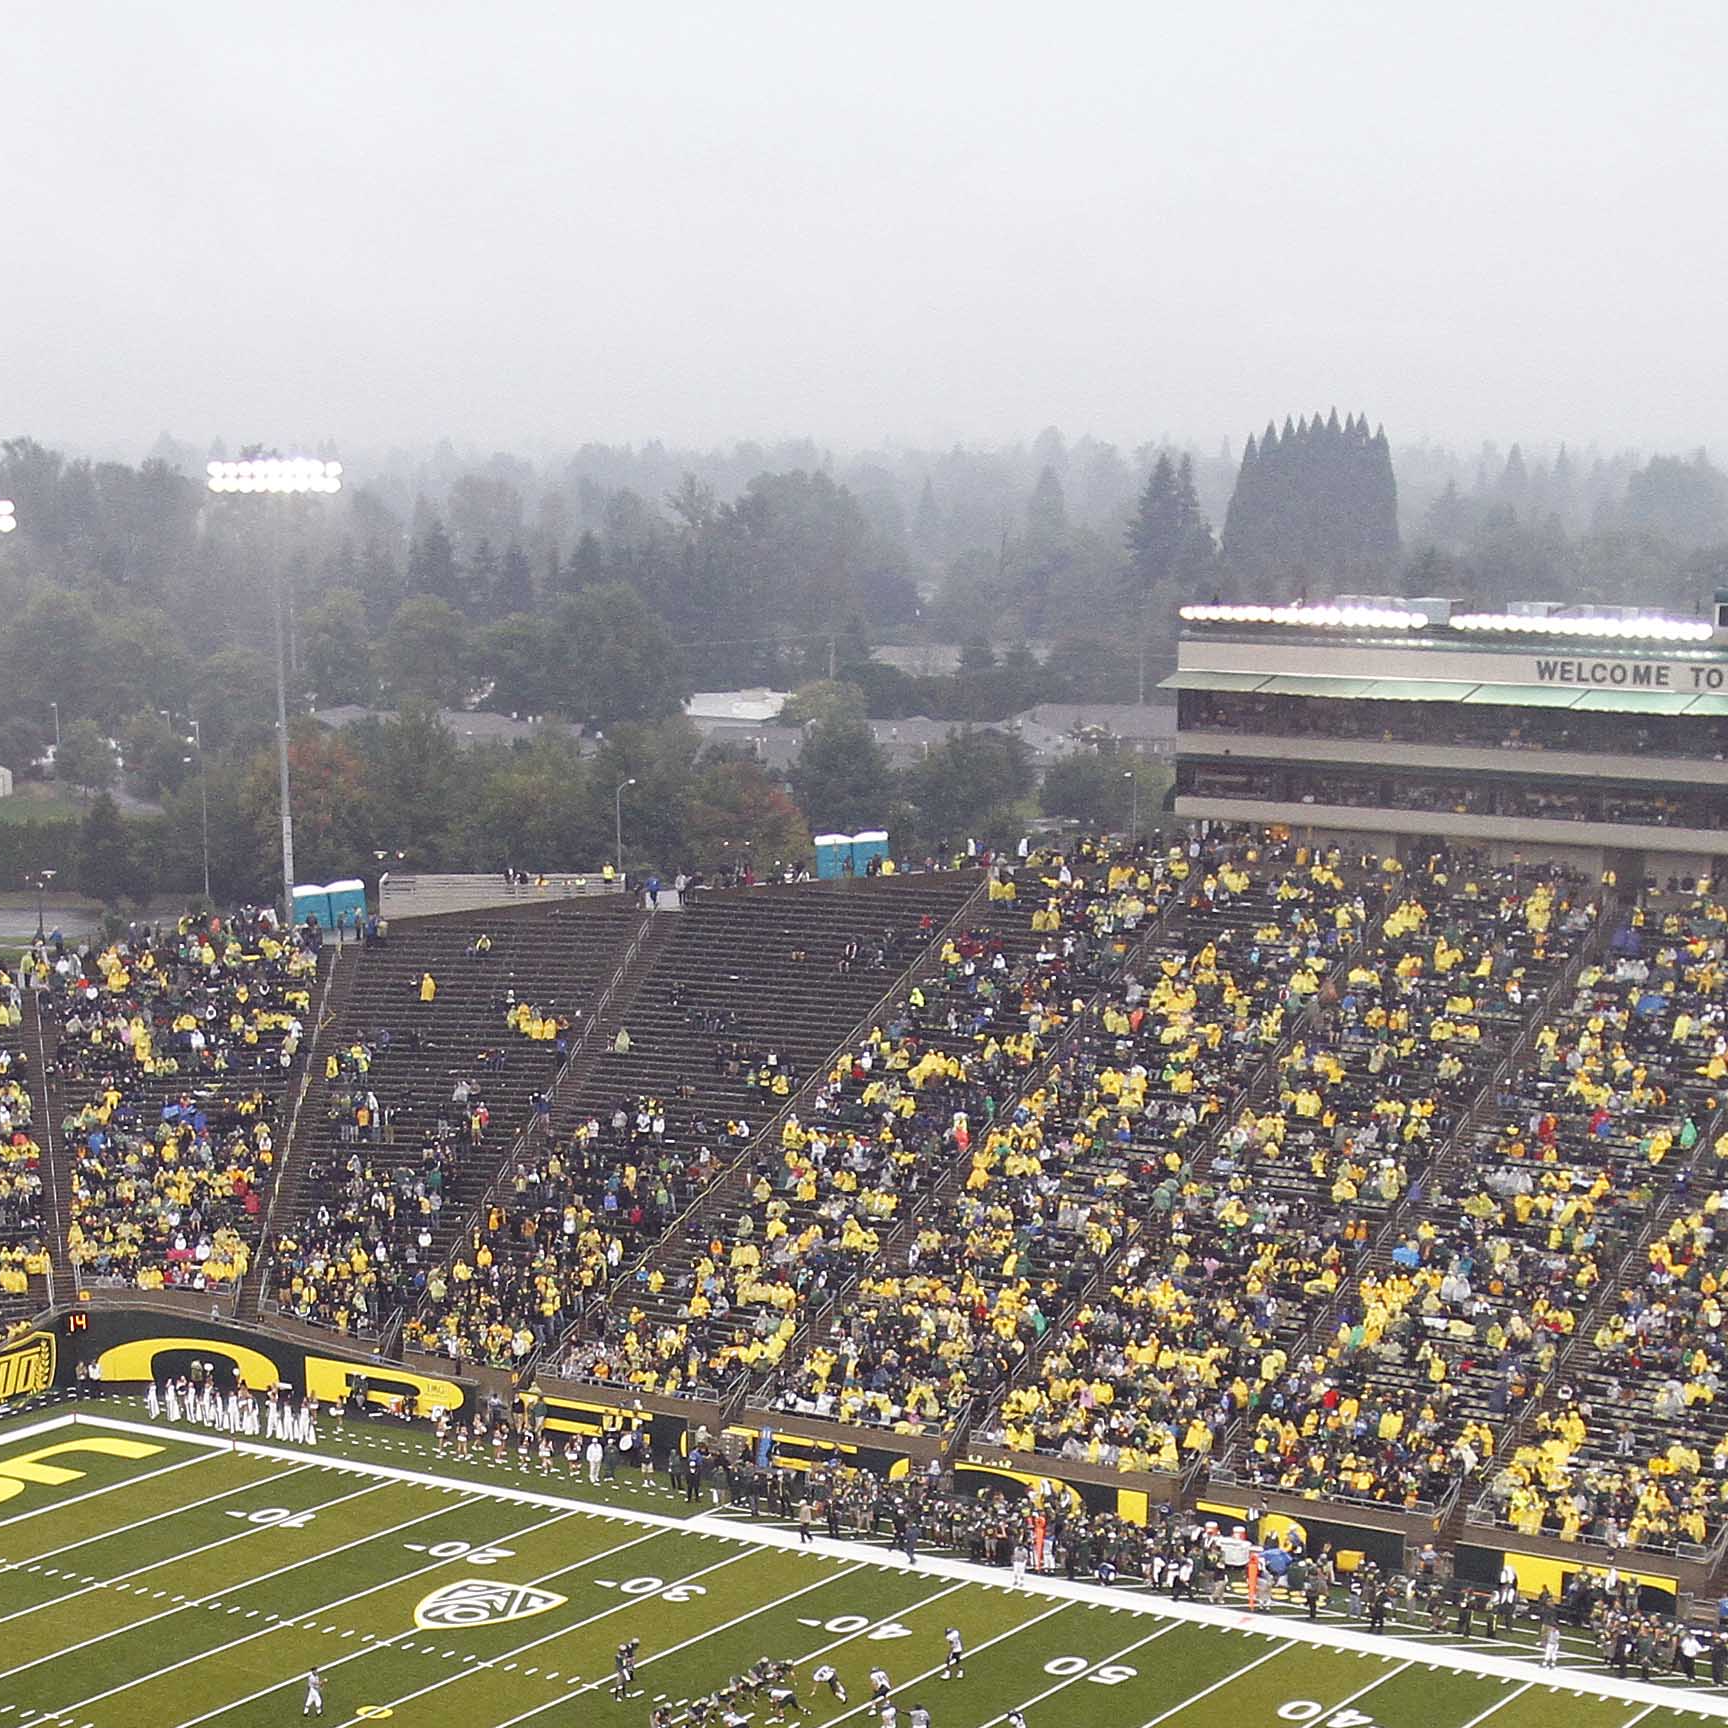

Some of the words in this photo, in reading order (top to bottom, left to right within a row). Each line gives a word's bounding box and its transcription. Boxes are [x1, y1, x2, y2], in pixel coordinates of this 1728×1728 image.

[1536, 660, 1670, 687] WELCOME
[1690, 667, 1724, 689] TO
[69, 1313, 88, 1333] 14
[247, 1507, 316, 1529] 10
[427, 1540, 516, 1564] 20
[619, 1576, 707, 1602] 30
[826, 1615, 912, 1641] 40
[1044, 1655, 1138, 1686] 50
